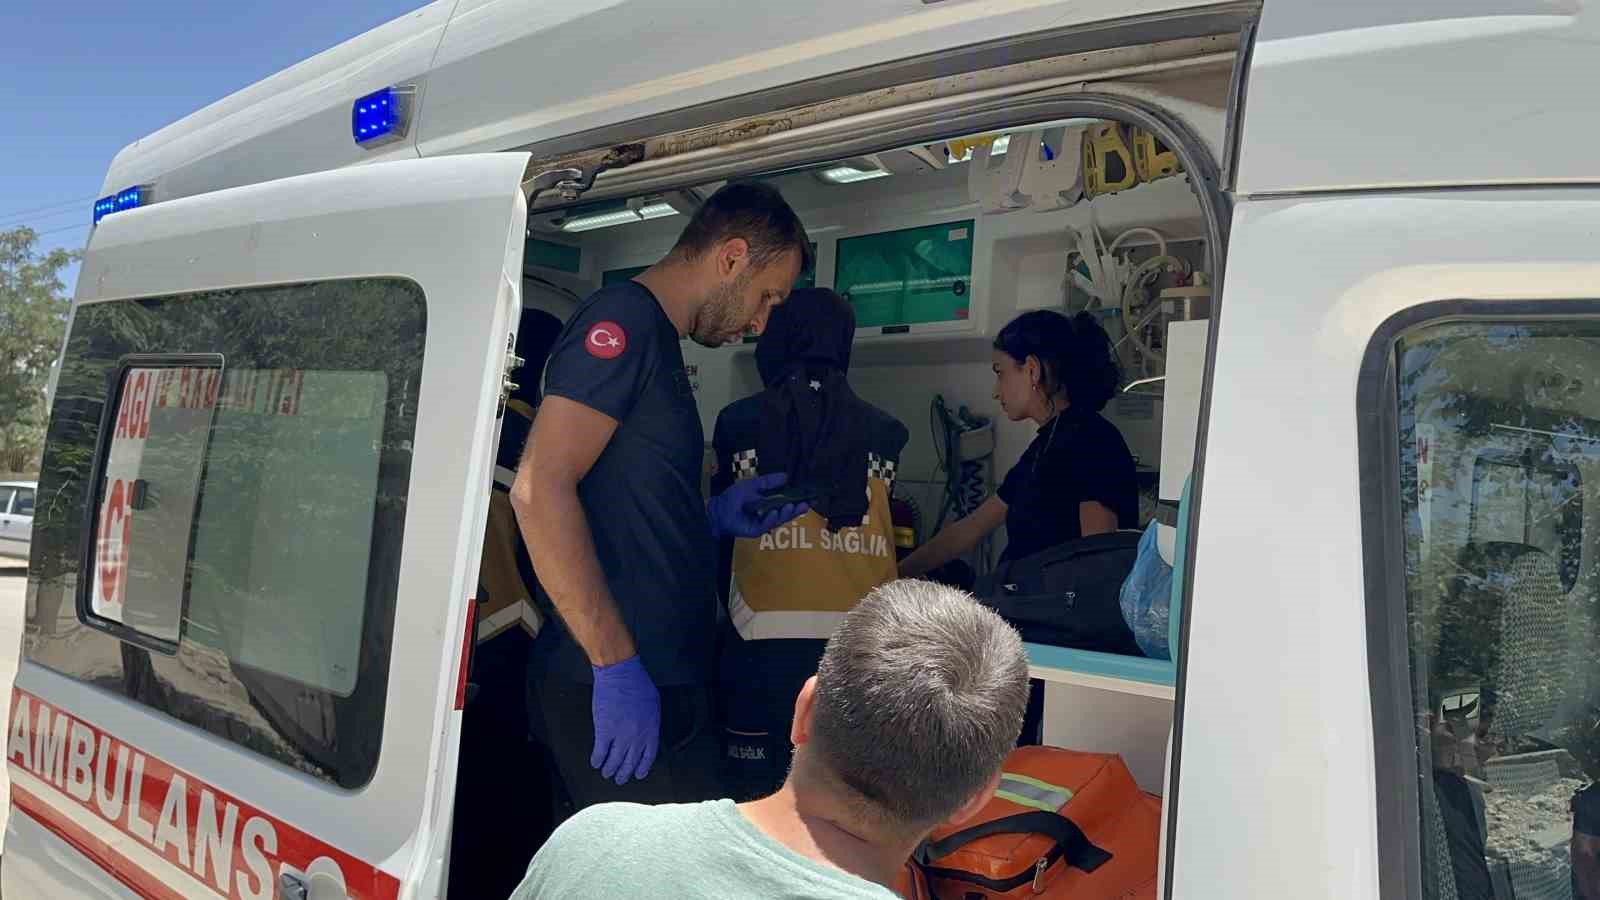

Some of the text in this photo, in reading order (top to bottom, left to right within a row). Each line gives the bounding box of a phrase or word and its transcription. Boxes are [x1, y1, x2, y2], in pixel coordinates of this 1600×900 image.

[759, 521, 889, 558] ACİL SAĞLIK
[7, 694, 278, 900] AMBULANS
